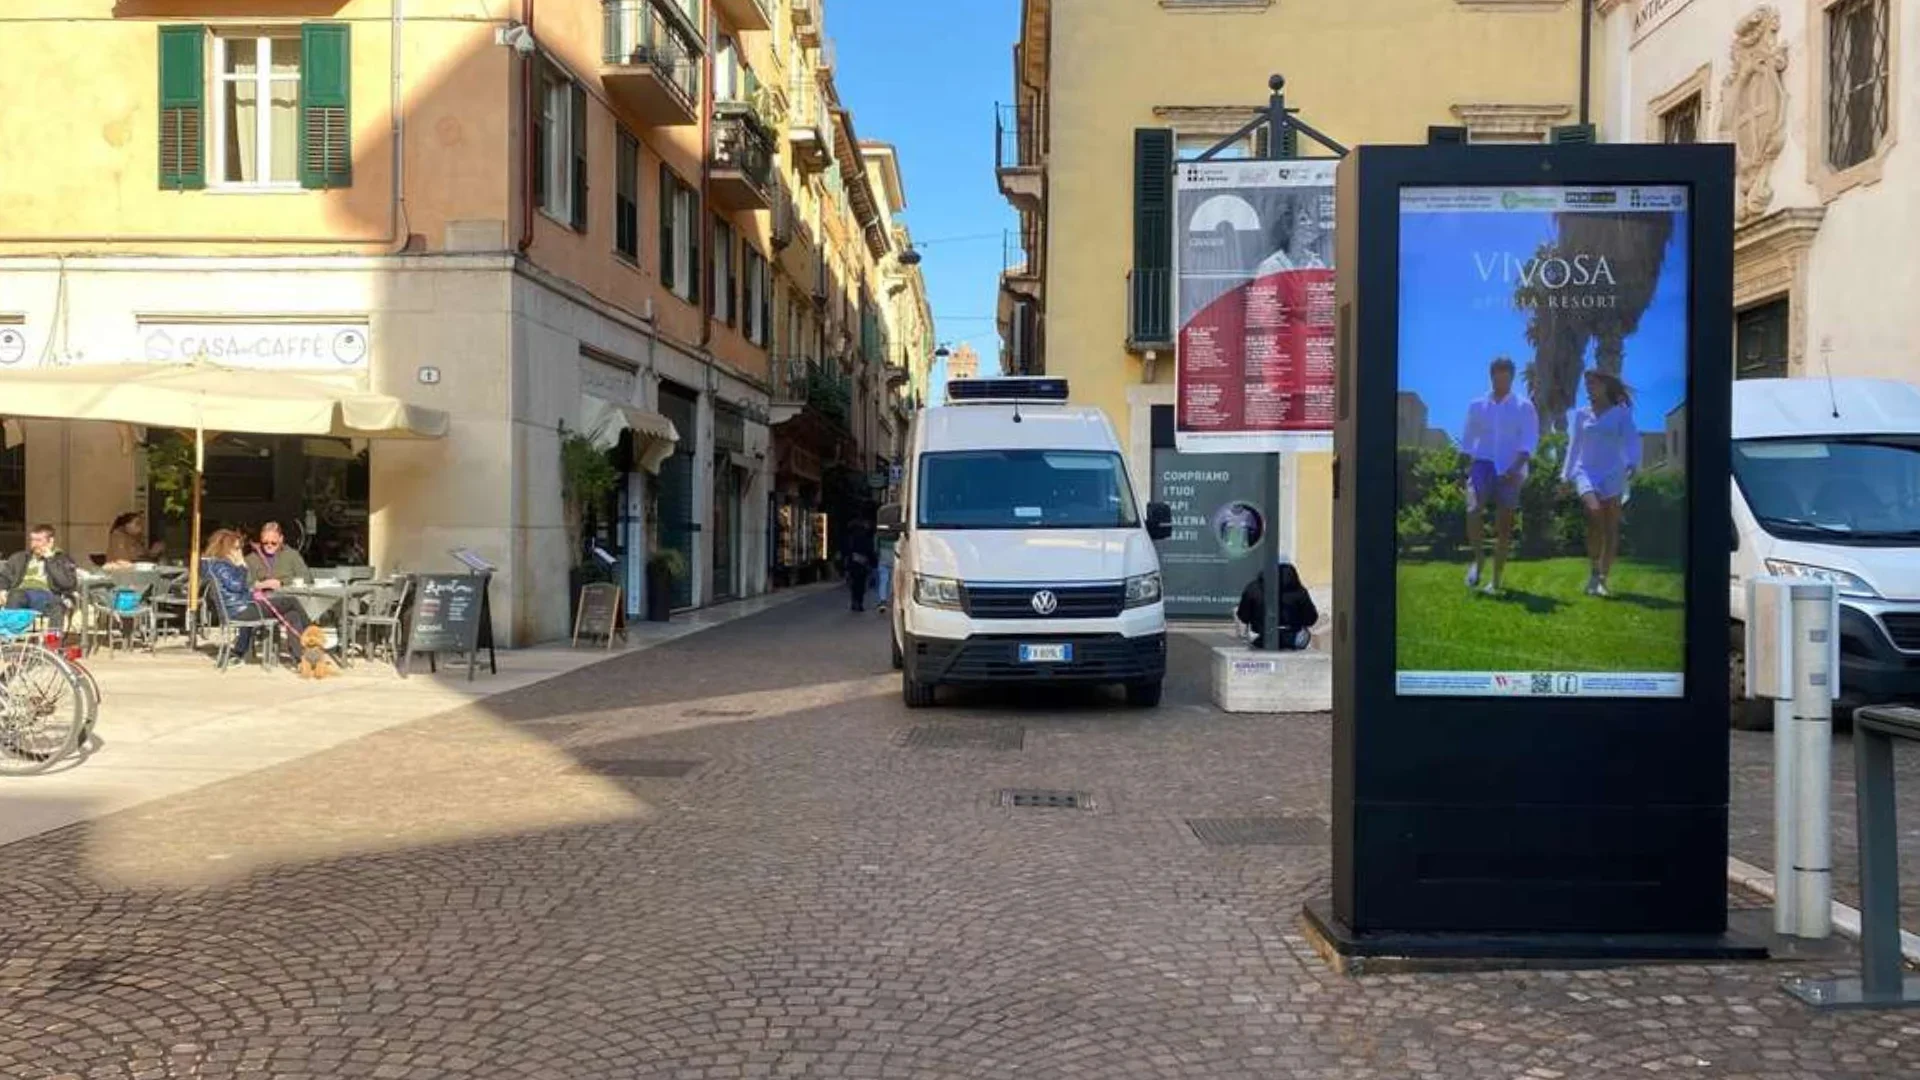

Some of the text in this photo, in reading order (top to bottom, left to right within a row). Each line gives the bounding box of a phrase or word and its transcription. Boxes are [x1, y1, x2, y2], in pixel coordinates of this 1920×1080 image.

[1473, 252, 1616, 288] VIVOSA
[1549, 295, 1615, 308] RESORT
[180, 337, 238, 358] CASA
[1163, 471, 1230, 481] COMPRIAMO
[1169, 486, 1194, 496] TUOI
